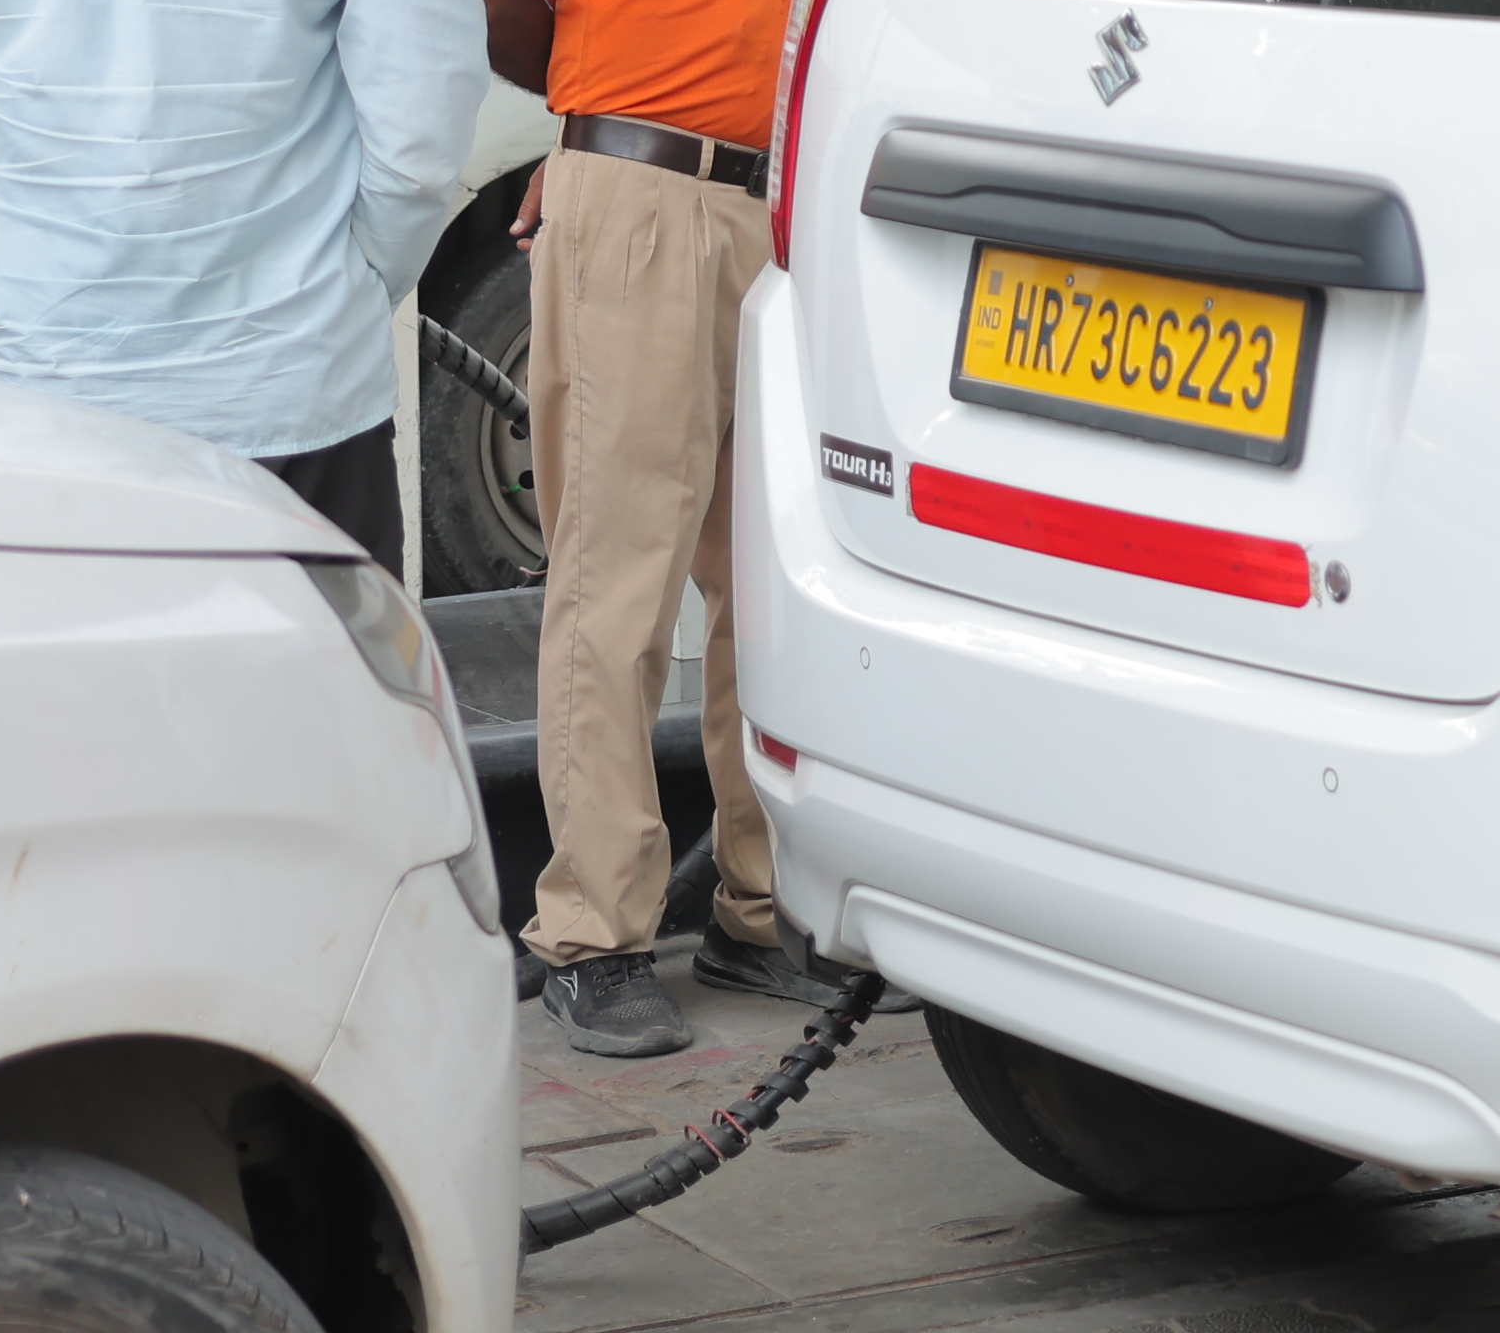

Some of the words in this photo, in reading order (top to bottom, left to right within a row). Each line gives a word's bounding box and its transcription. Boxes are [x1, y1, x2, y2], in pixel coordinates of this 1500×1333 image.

[977, 304, 1002, 330] IND
[1004, 281, 1275, 411] HR73C6223
[822, 447, 867, 477] TOUR
